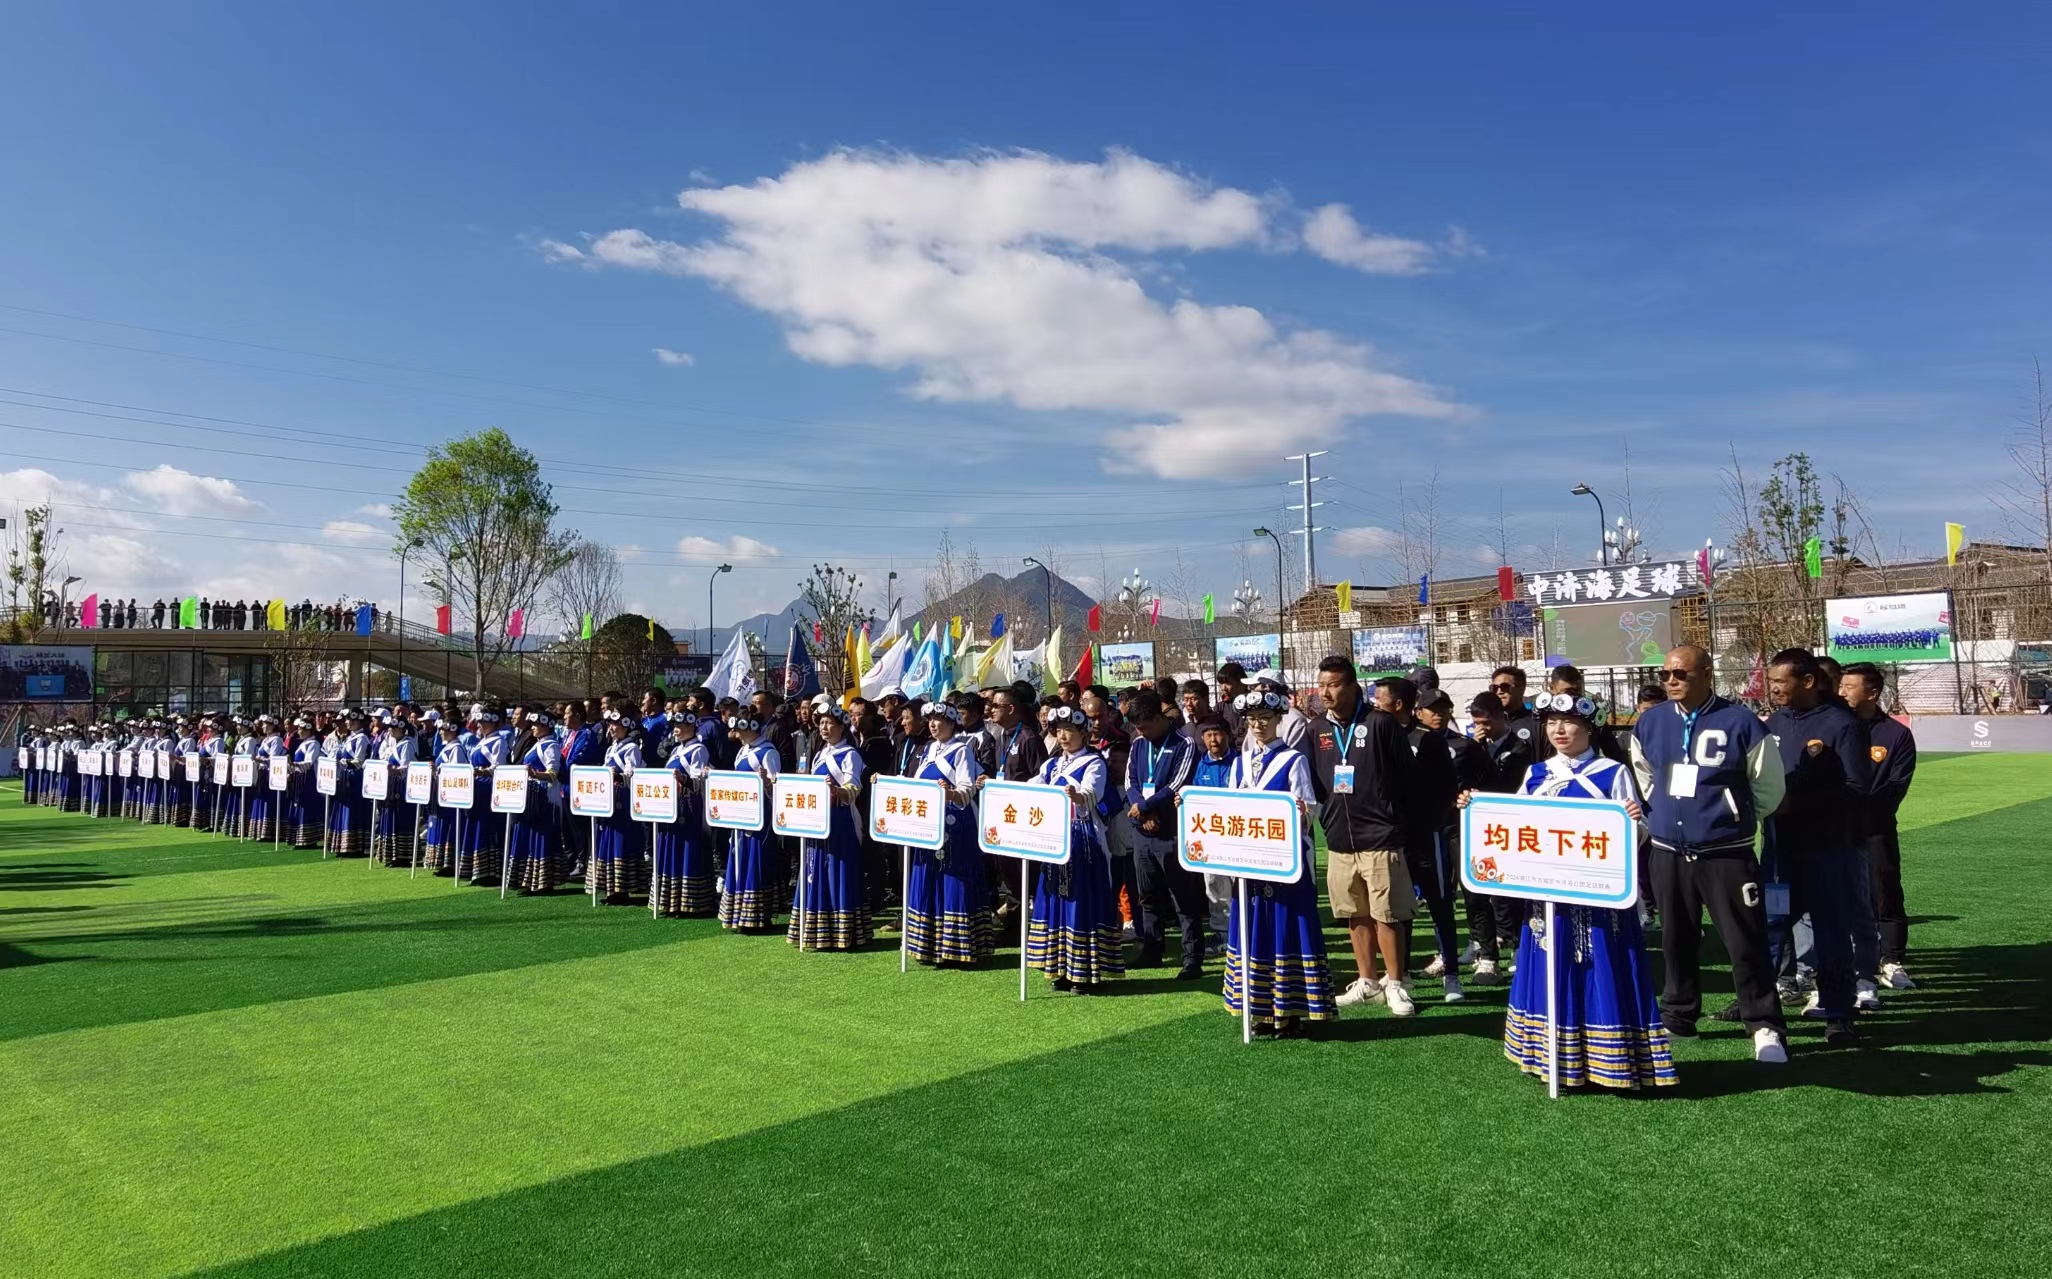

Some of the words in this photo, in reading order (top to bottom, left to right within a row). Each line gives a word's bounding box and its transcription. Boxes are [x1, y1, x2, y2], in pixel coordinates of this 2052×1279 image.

[1527, 562, 1683, 605] 中济海足球
[1355, 738, 1366, 748] 88
[1695, 729, 1728, 767] C
[636, 783, 670, 799] 丽江公交
[886, 795, 928, 819] 绿彩若
[1190, 812, 1287, 842] 火鸟游乐园
[1484, 823, 1611, 861] 均良下村
[1742, 882, 1760, 907] C
